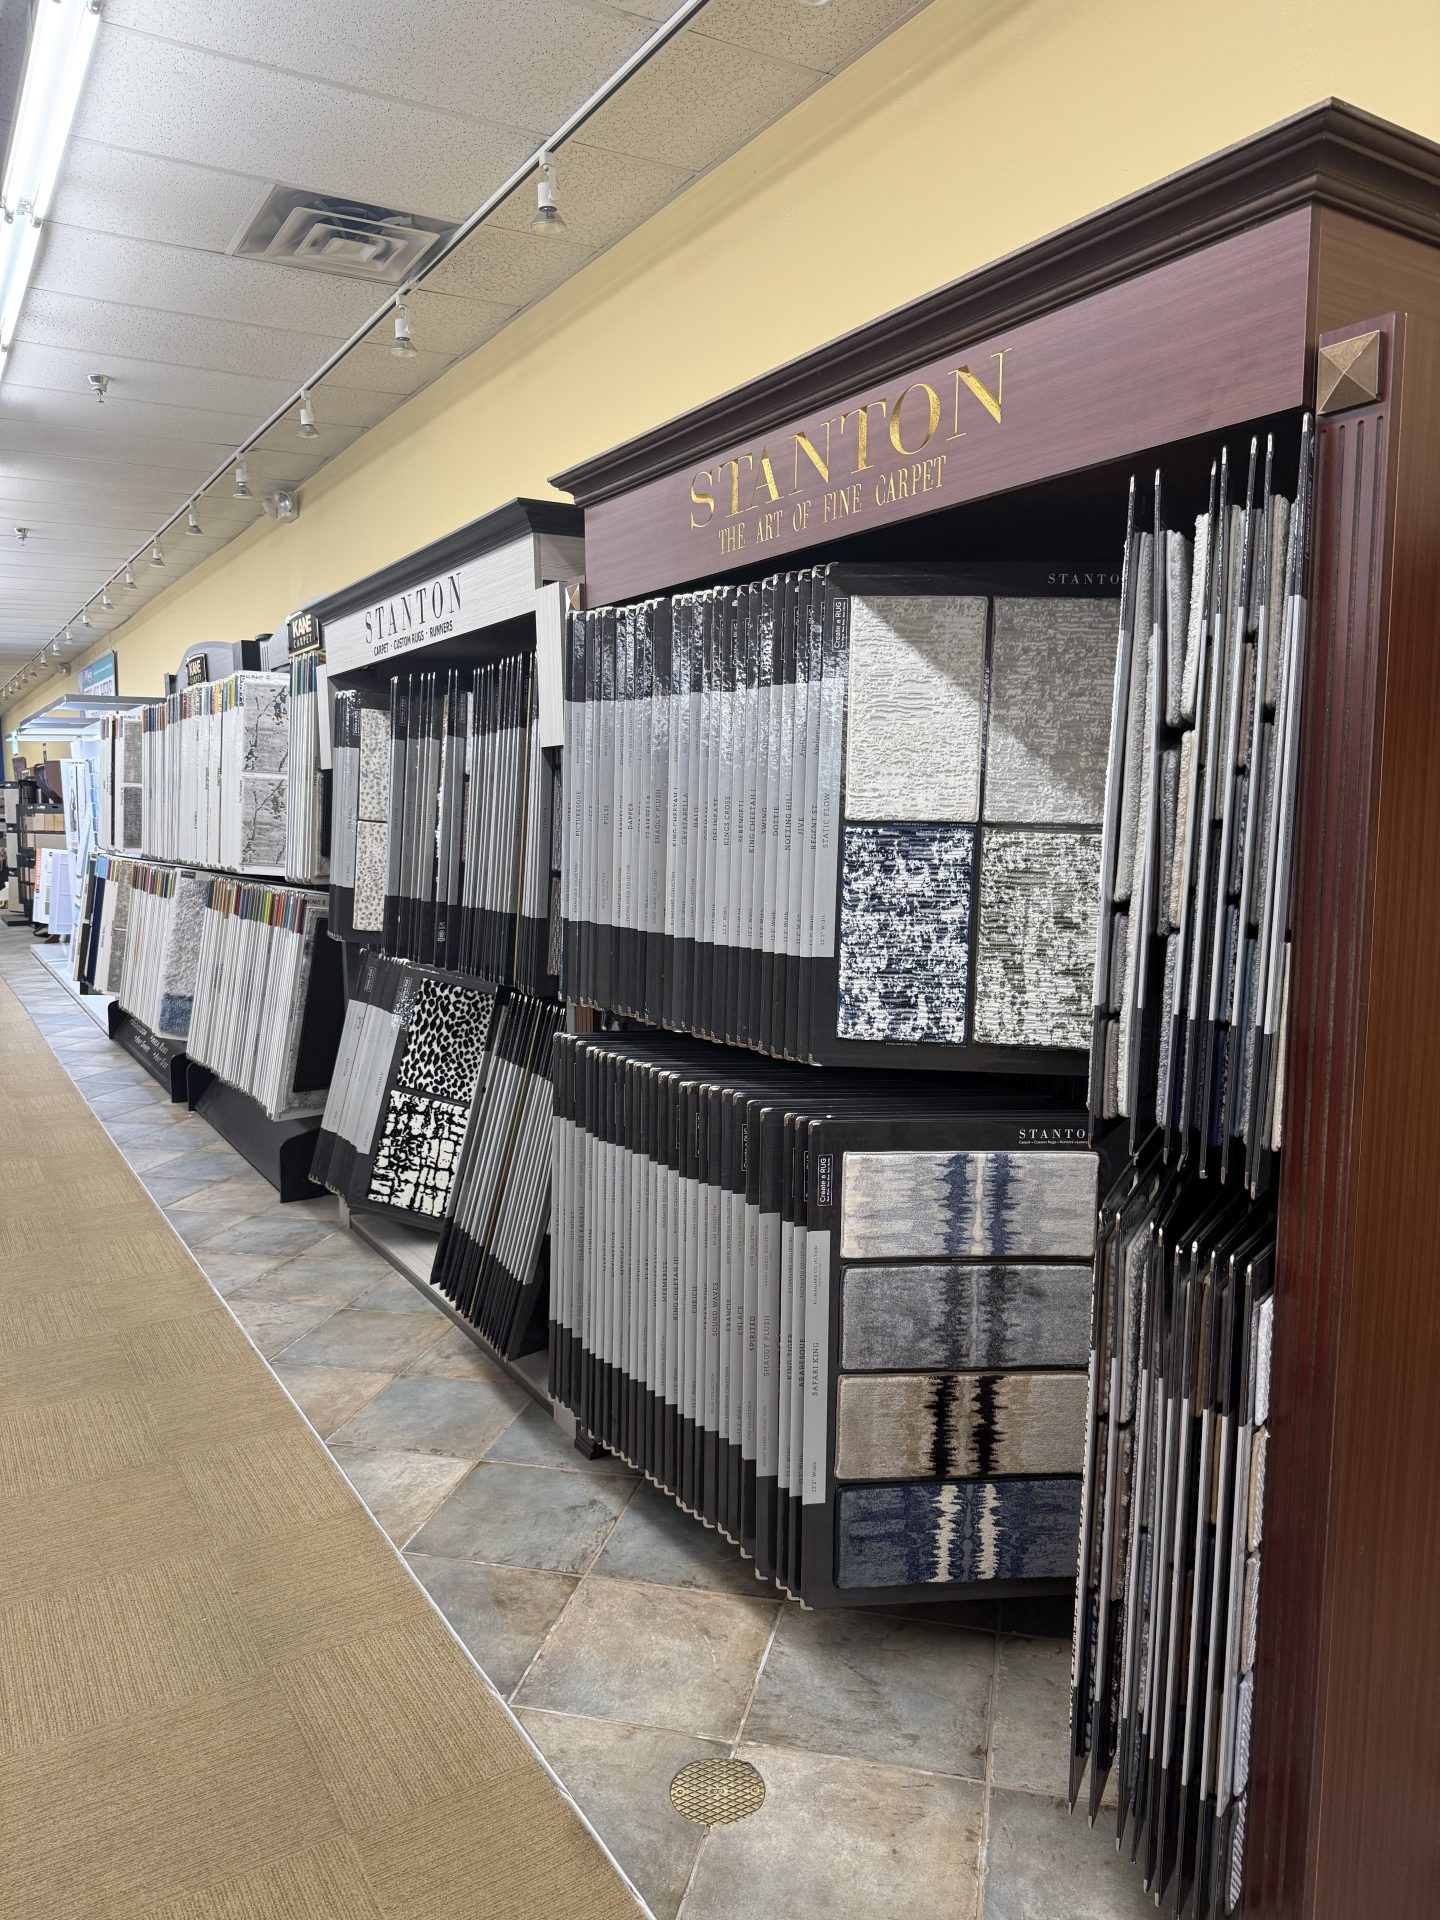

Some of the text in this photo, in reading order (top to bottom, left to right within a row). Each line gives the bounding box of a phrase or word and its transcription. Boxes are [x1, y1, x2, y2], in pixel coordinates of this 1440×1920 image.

[690, 348, 1012, 531] STANTON
[719, 455, 947, 554] THE ART OF FINE CARPET
[1047, 573, 1120, 585] STANTO
[365, 572, 462, 644] STANTON
[292, 614, 312, 639] KANE
[373, 620, 453, 656] CARPET CUSTOM RUGS RUNNERS
[1018, 1128, 1086, 1139] STANTO
